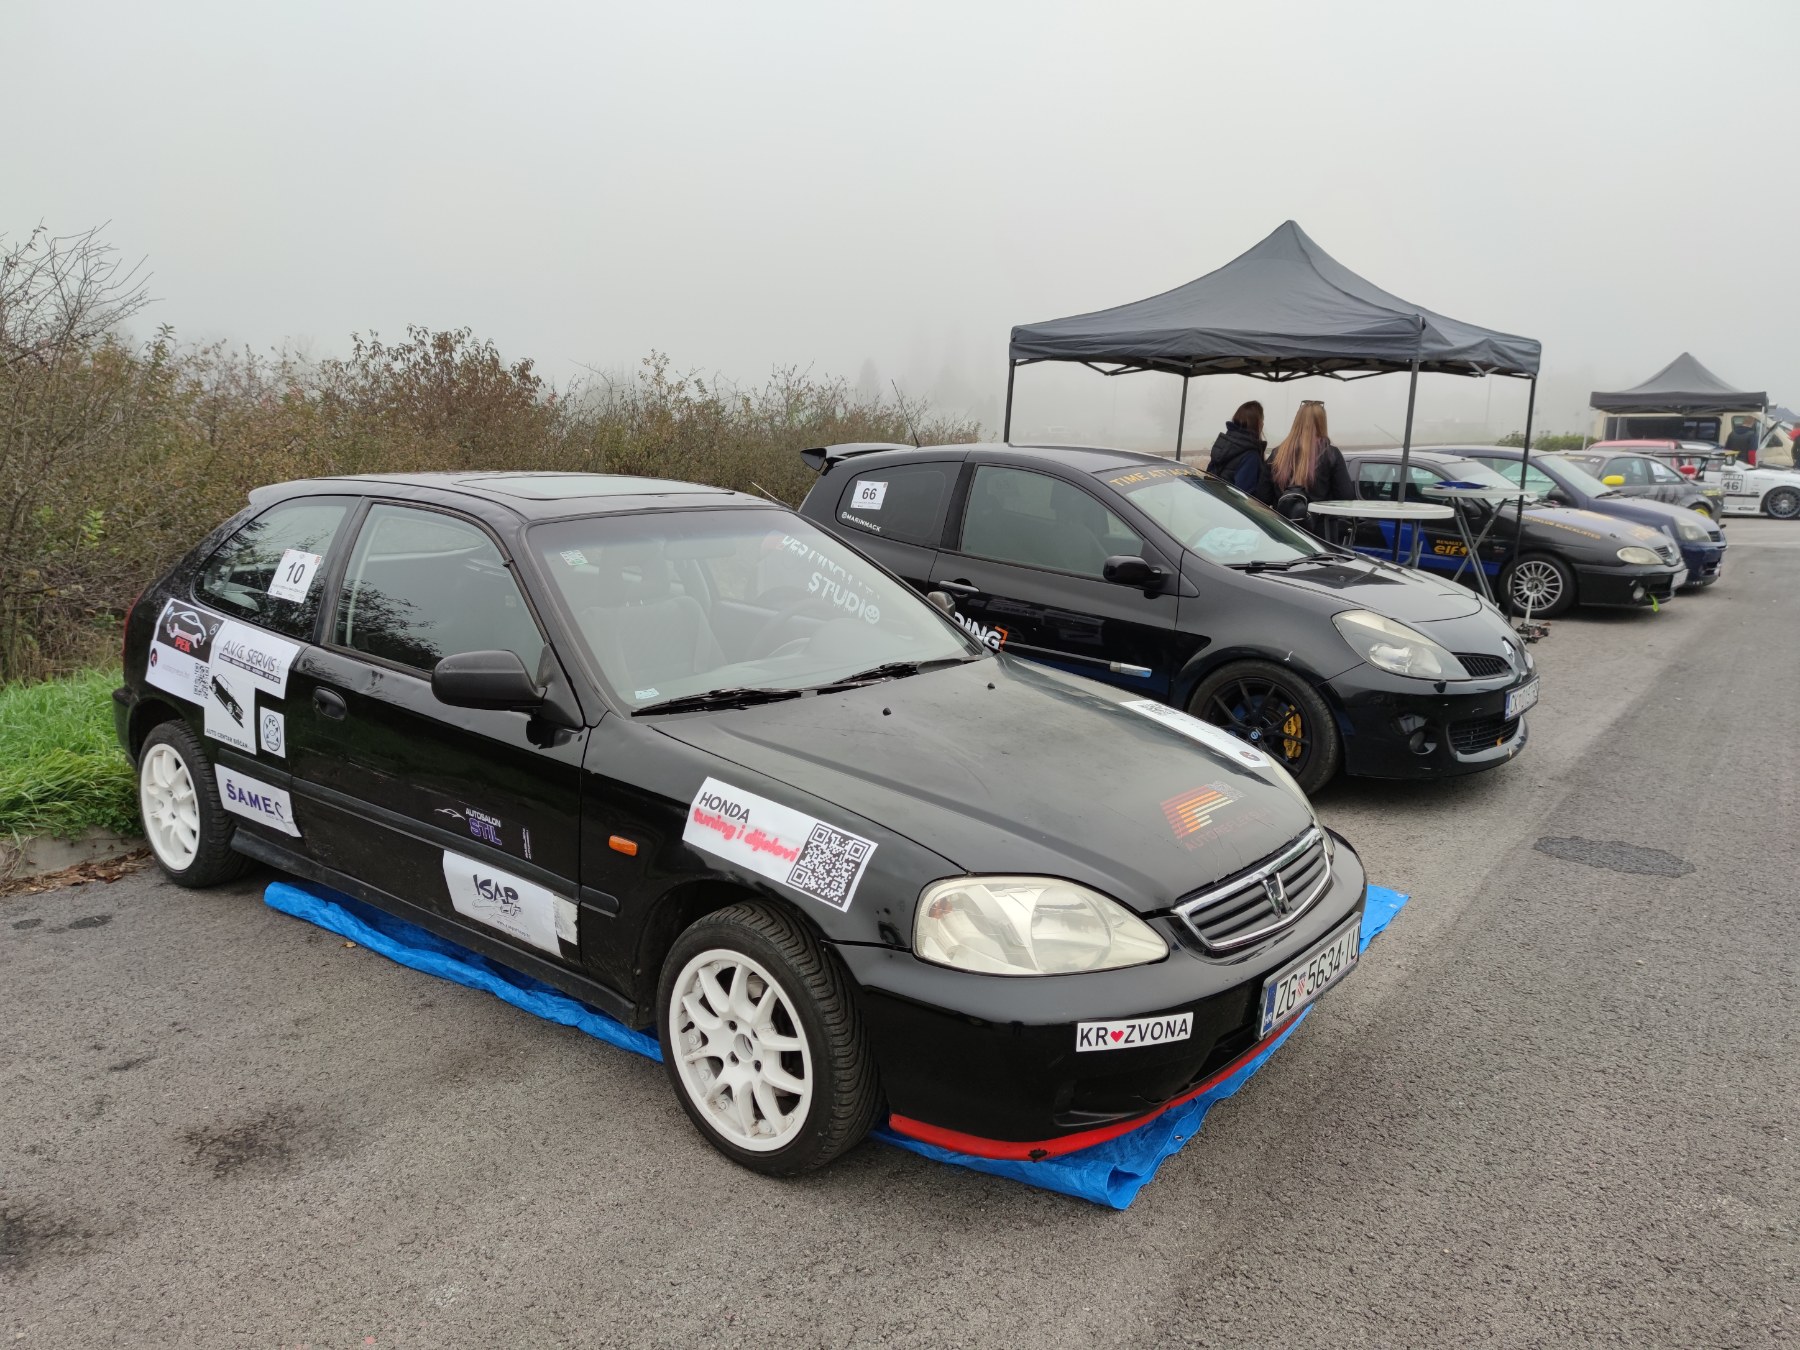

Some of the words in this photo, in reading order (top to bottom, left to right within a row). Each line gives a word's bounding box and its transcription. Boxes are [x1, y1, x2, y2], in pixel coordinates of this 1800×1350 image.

[1109, 472, 1150, 487] TIME
[1723, 481, 1739, 491] 46
[862, 487, 877, 500] 66
[841, 511, 881, 532] @MARINMACK
[1434, 545, 1459, 555] elf
[286, 561, 306, 584] 10
[245, 648, 277, 673] SERVIS
[465, 807, 501, 828] AUTOSALON
[699, 792, 750, 823] HONDA
[468, 817, 503, 846] STIL
[736, 824, 746, 840] i
[1275, 973, 1298, 1020] ZG
[1078, 1025, 1109, 1048] KR
[1123, 1017, 1189, 1045] ZVONA
